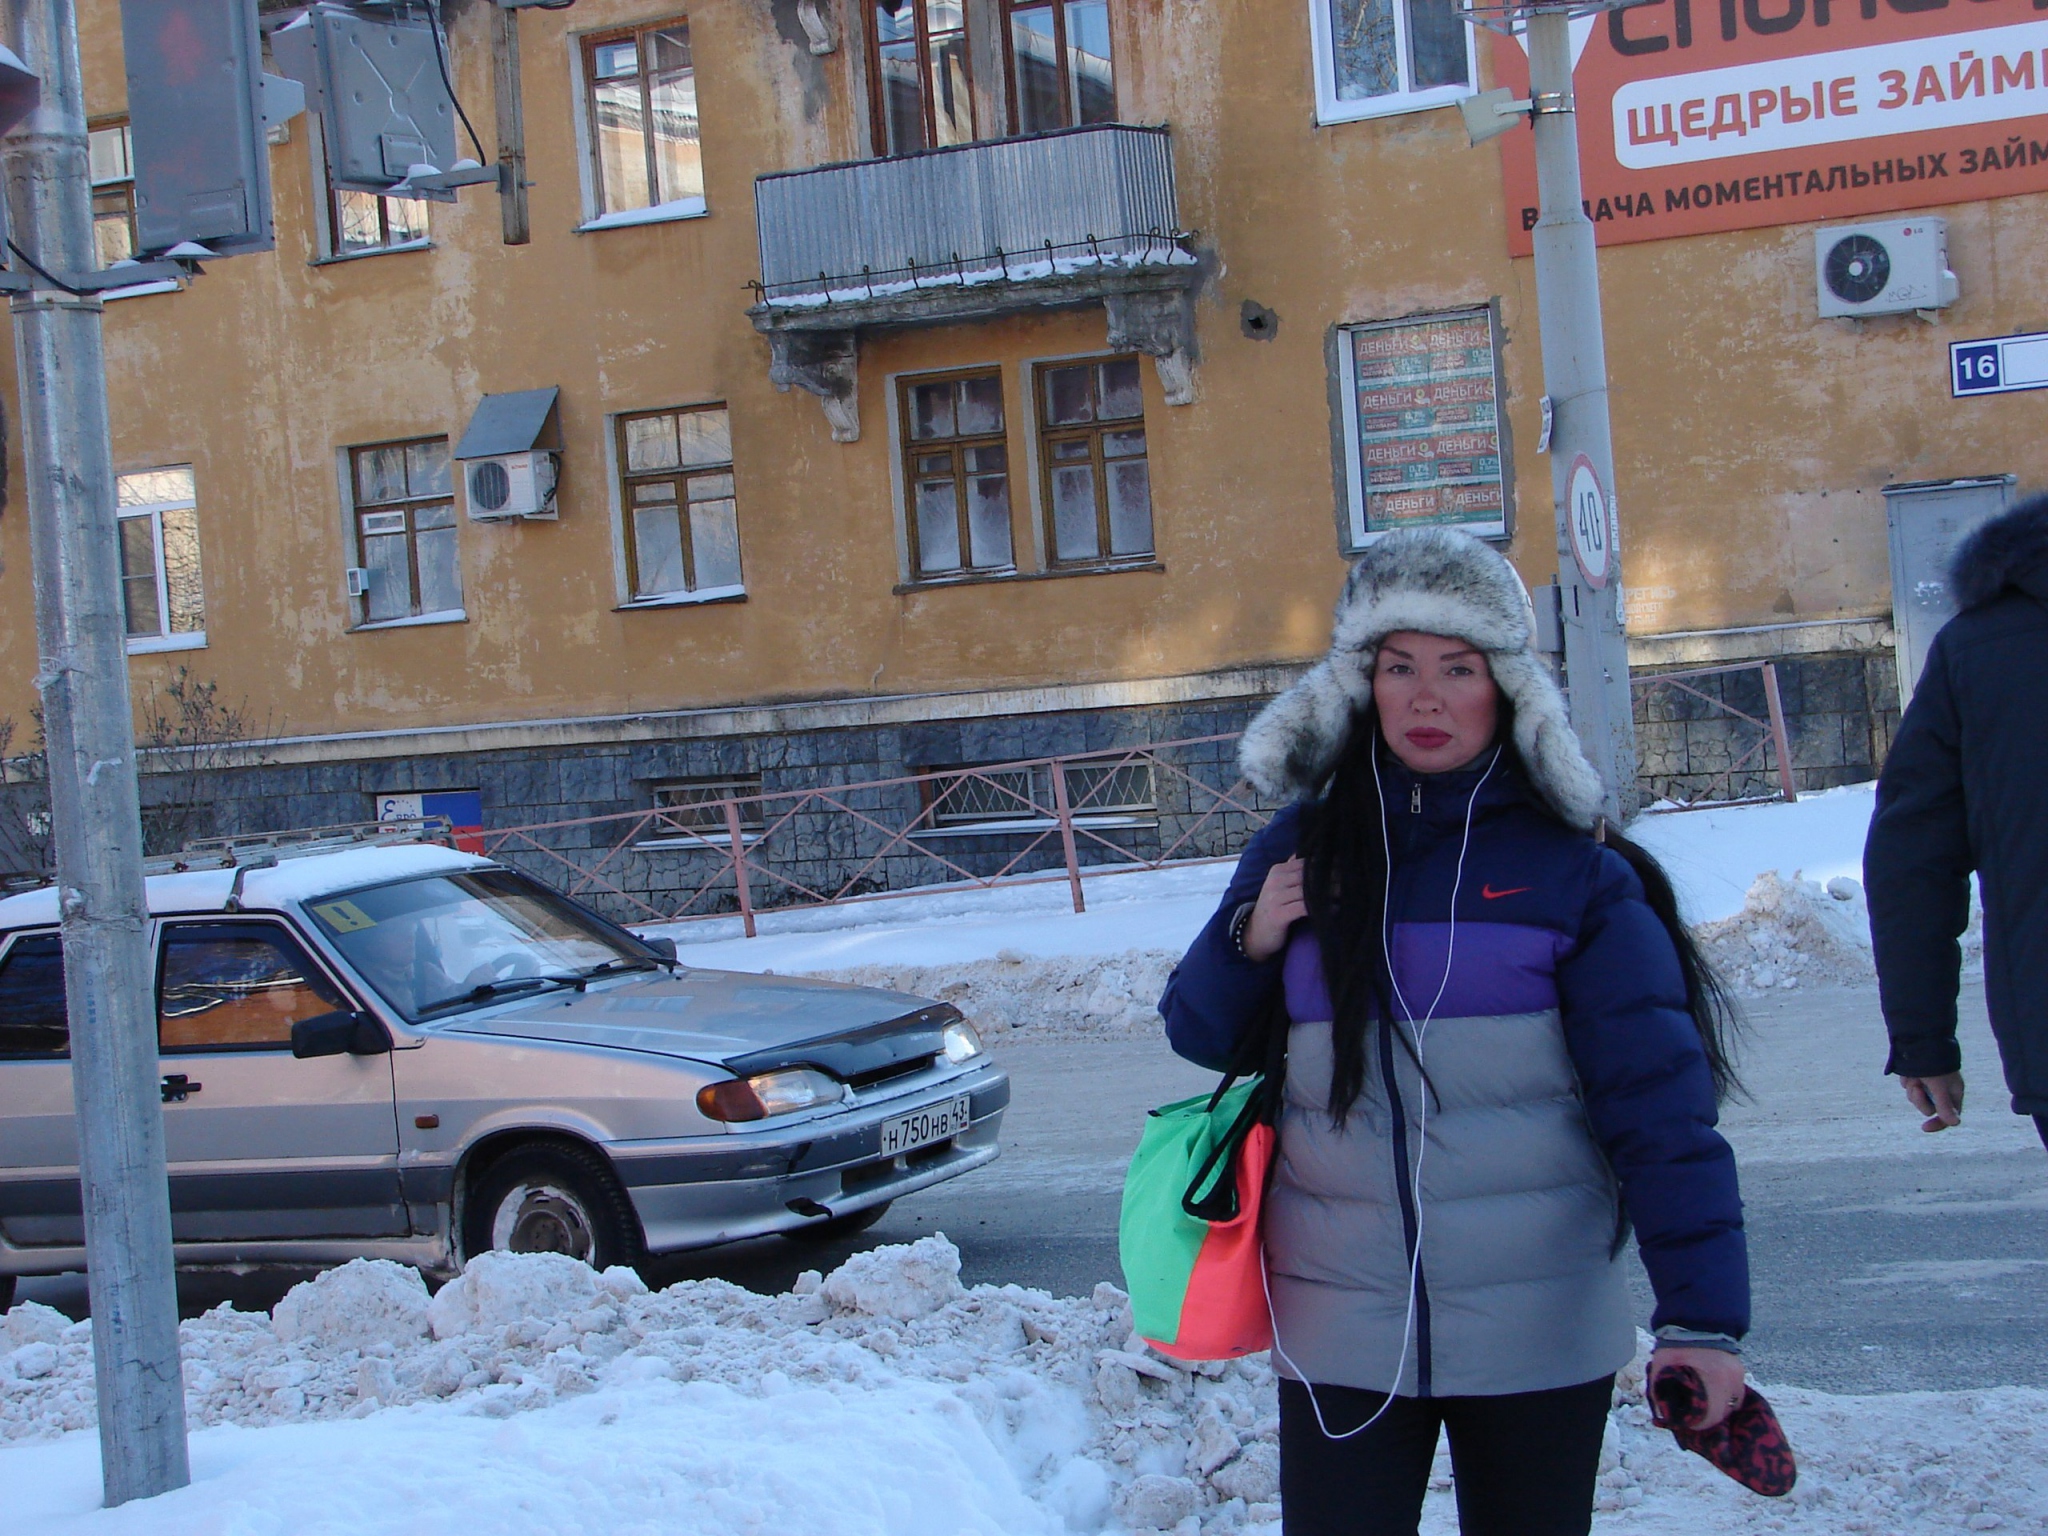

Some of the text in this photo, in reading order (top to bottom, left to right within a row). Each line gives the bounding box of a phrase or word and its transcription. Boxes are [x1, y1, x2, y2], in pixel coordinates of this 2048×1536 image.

[1627, 48, 2048, 147] ЩЕДРЫЕ ЗАЙМ
[1521, 192, 1655, 231] ВАЧА
[1665, 152, 1949, 212] МОМЕНТАЛЬНЫХ
[1430, 330, 1480, 347] ДЕНЬГИ
[1960, 354, 1996, 380] 16
[1363, 392, 1412, 408] ДЕНЬГИ
[1433, 383, 1483, 400] ДЕНЬГИ
[1437, 436, 1486, 453] ДЕНЬГИ
[1367, 445, 1416, 462] ДЕНЬГИ
[1385, 496, 1435, 512] ДЕНЬГИ
[1579, 491, 1602, 552] 40
